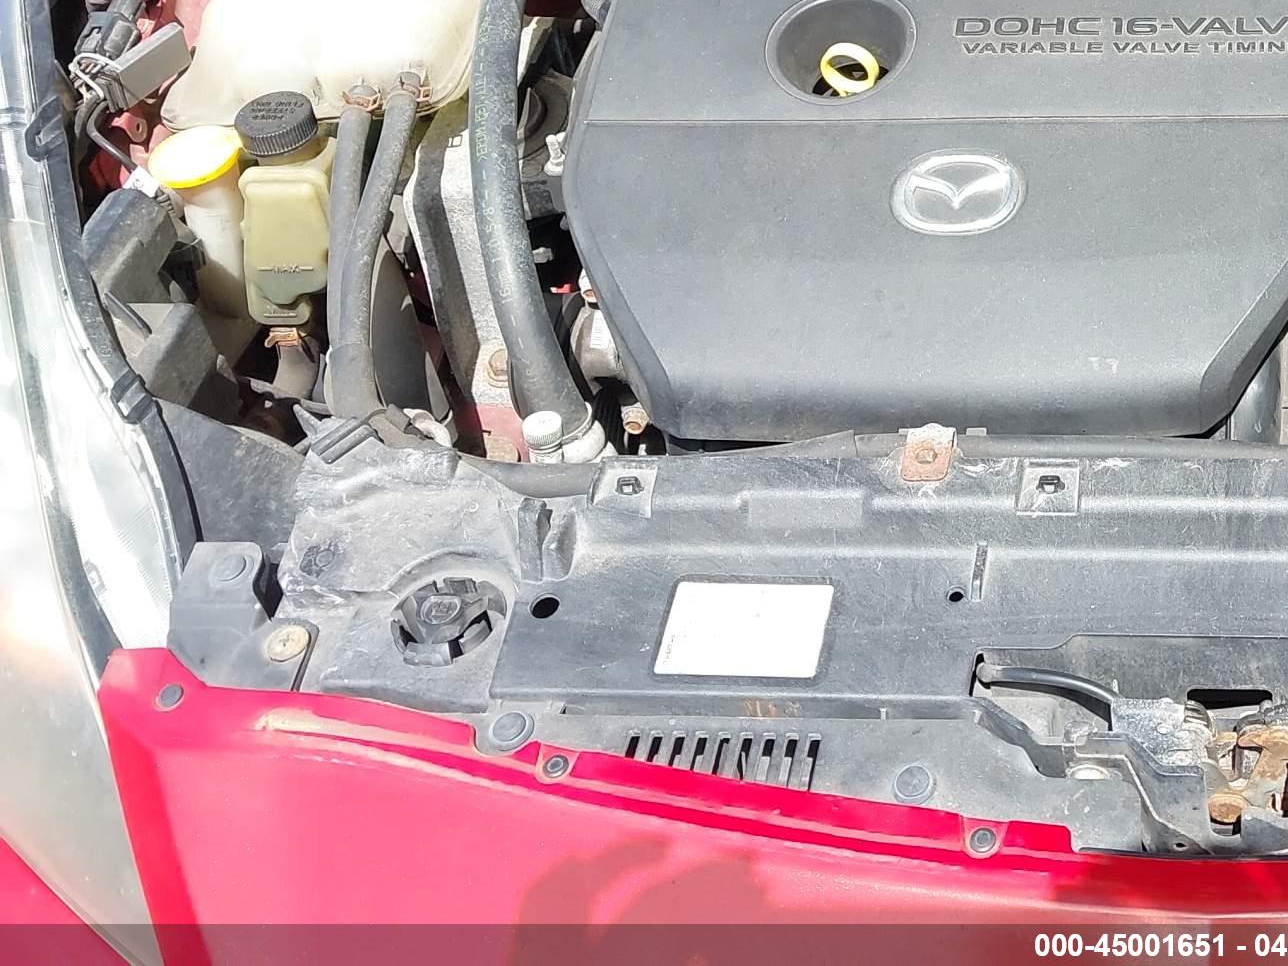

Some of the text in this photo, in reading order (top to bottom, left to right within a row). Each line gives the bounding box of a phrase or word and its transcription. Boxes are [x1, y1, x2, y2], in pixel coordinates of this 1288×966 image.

[955, 17, 1102, 35] DOHC
[963, 41, 1104, 54] VARIABLE
[1112, 41, 1201, 54] VALVE
